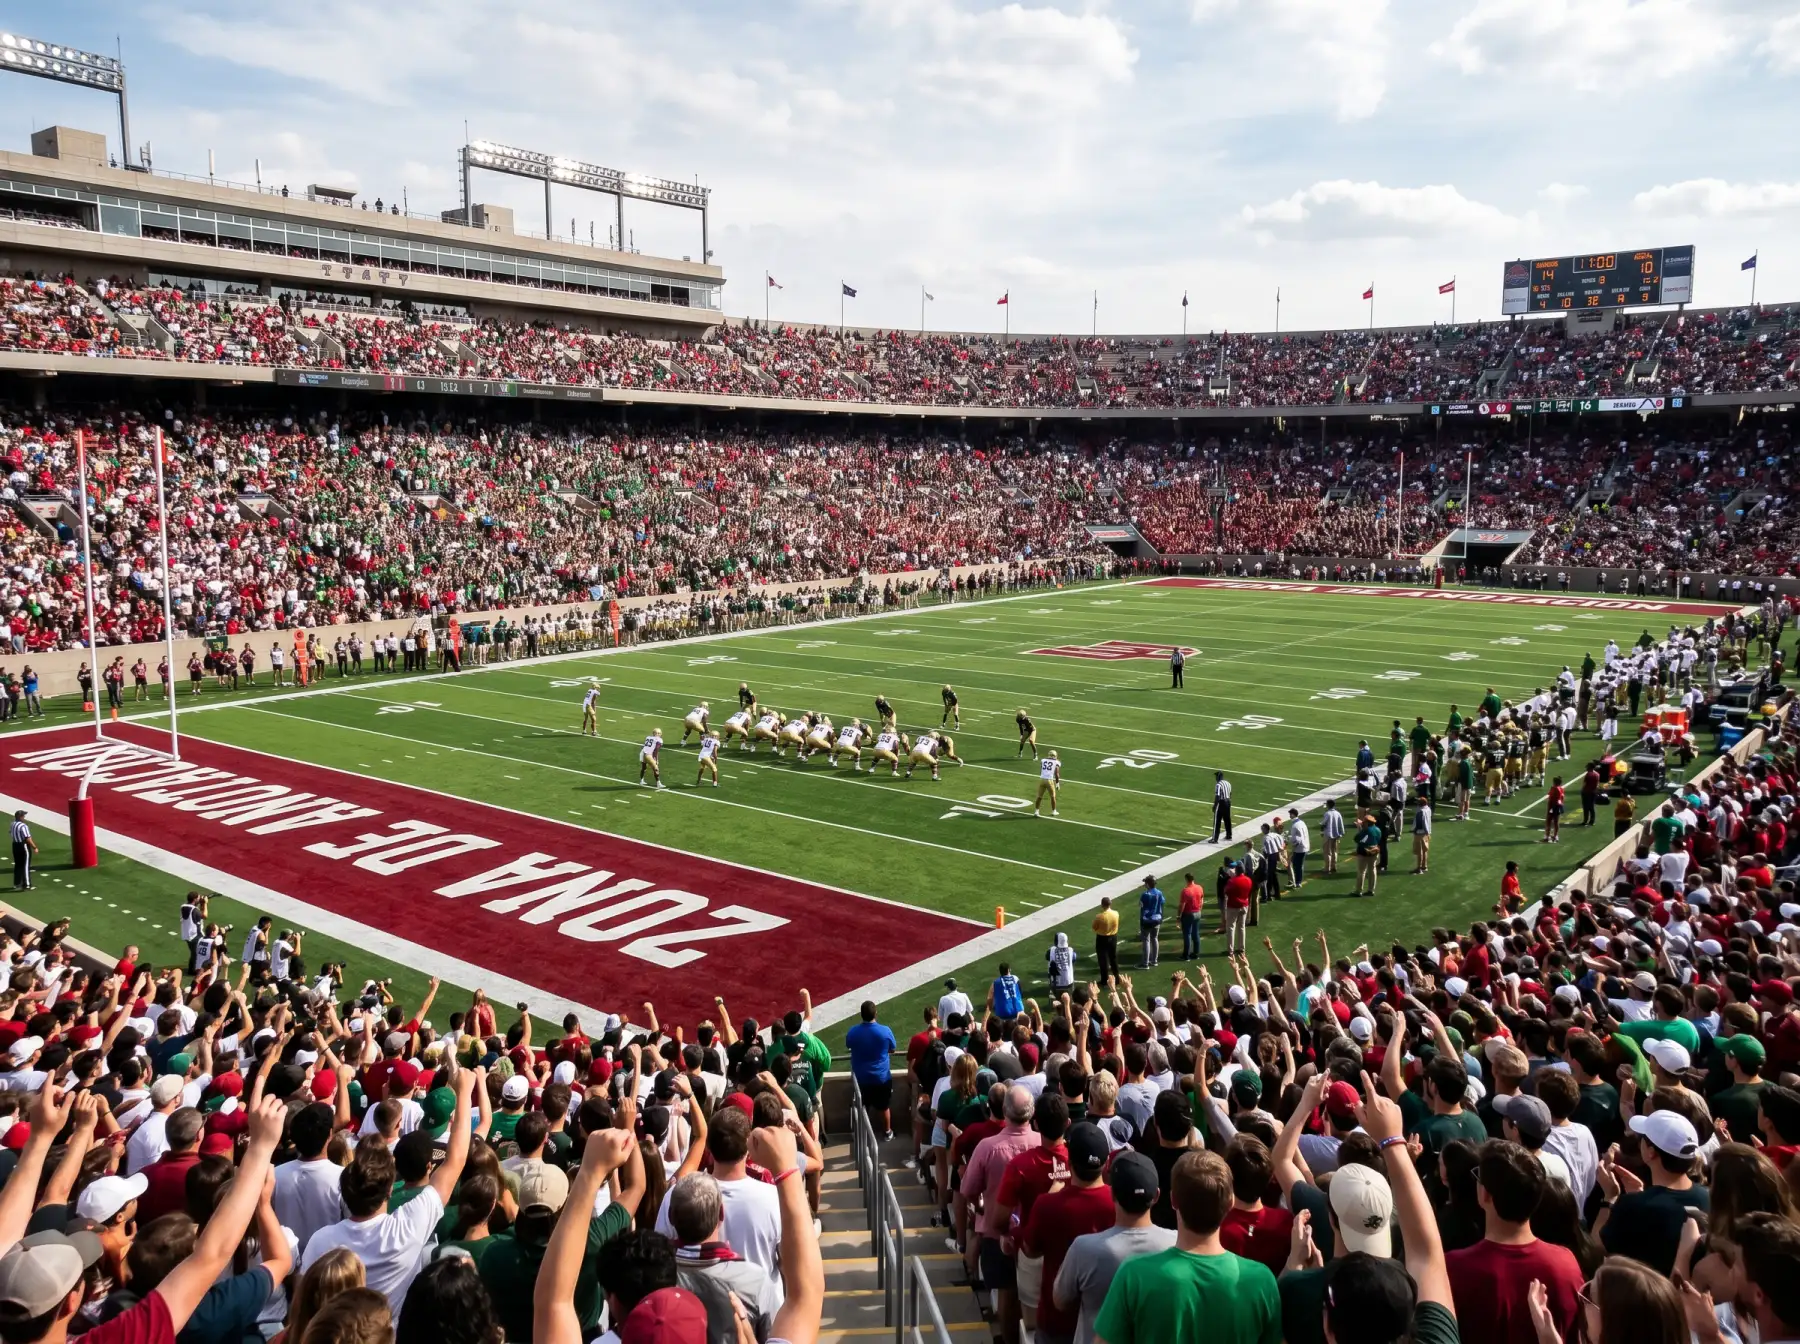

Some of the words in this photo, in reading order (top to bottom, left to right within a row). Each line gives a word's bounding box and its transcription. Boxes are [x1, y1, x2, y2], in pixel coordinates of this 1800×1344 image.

[1542, 270, 1554, 280] 14
[1641, 261, 1653, 274] 10
[1561, 298, 1571, 308] 10
[1579, 401, 1592, 410] 16
[1221, 714, 1284, 730] 30
[1101, 749, 1180, 769] 20
[950, 795, 1034, 818] 10
[301, 819, 503, 877] DE
[433, 851, 792, 969] ZONA
